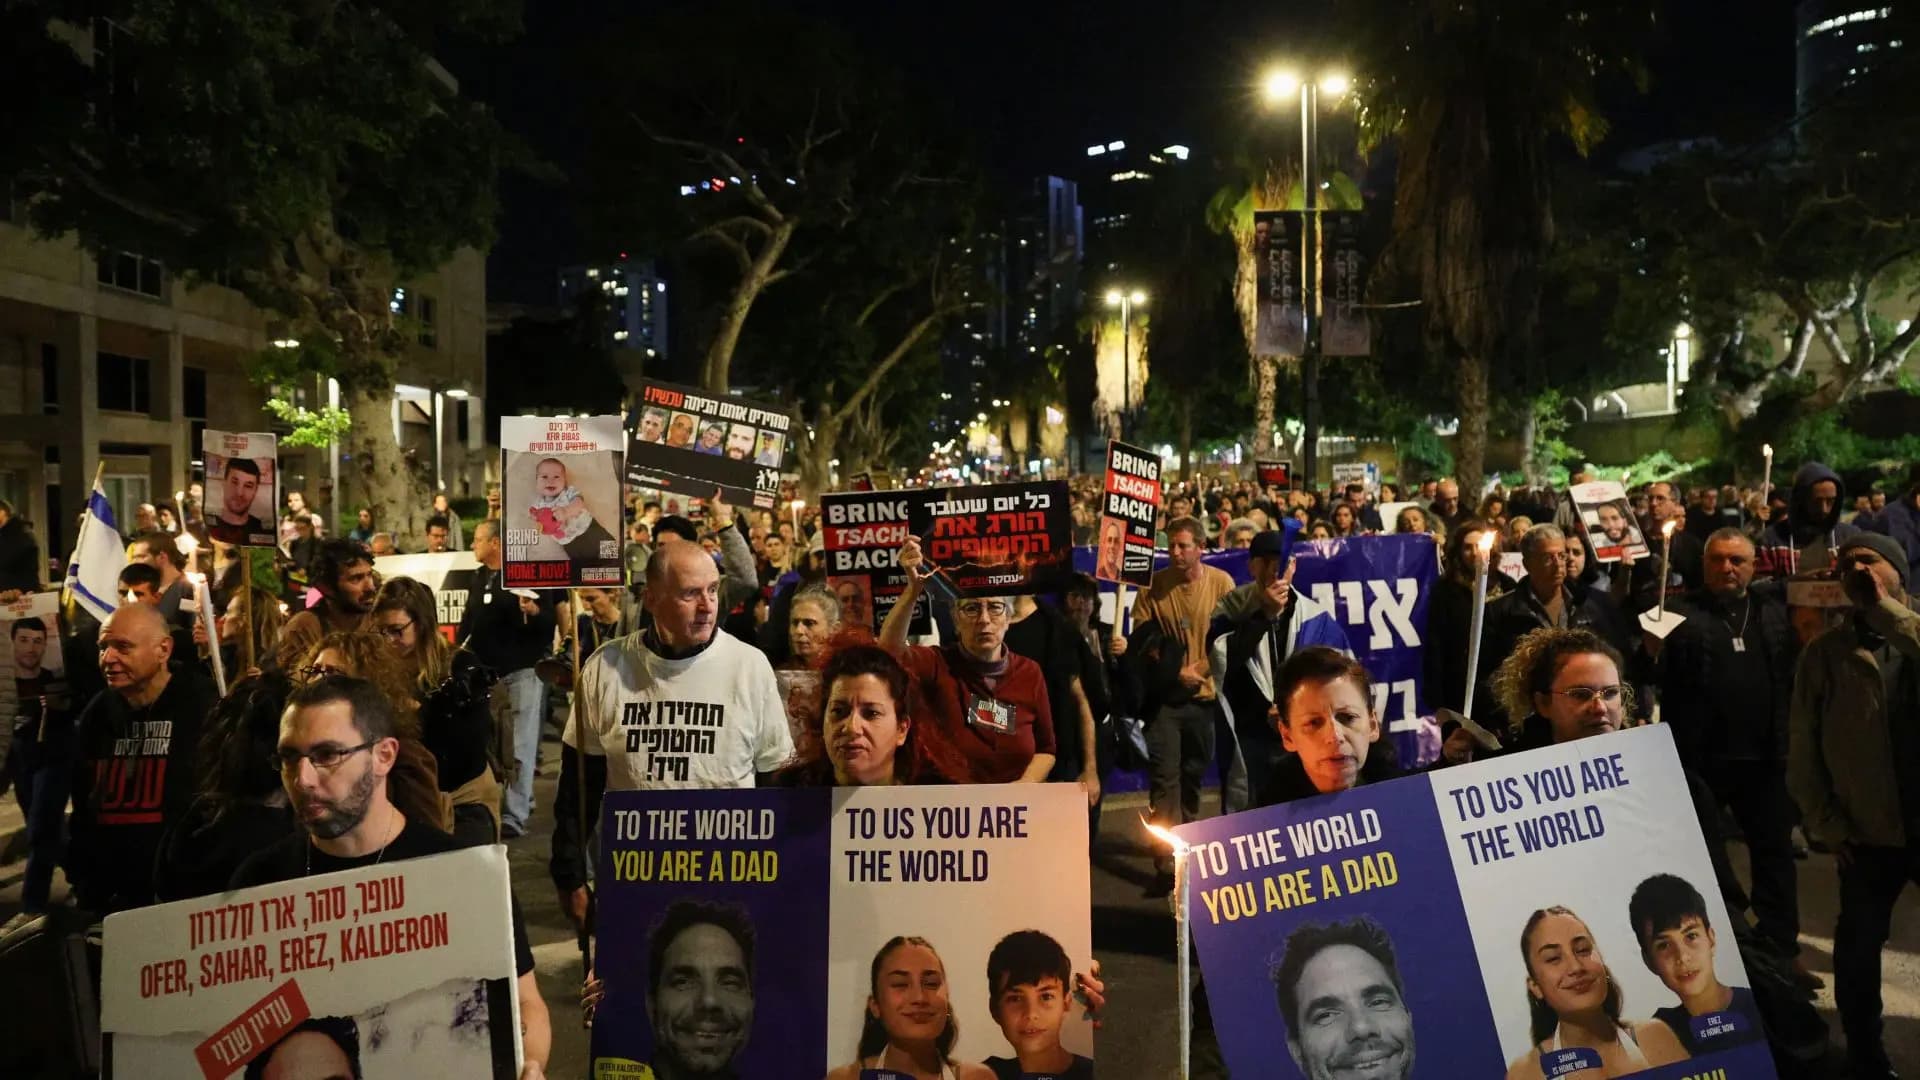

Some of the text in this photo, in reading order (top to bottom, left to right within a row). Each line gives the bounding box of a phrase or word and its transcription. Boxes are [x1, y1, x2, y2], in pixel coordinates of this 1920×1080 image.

[684, 395, 718, 415] הביתה
[719, 402, 748, 422] אותם
[748, 408, 790, 430] מחזירים
[546, 432, 580, 441] KFIR BIBAS
[1111, 450, 1158, 481] BRING
[1112, 473, 1155, 500] TSACHI
[828, 500, 909, 524] BRING
[924, 491, 1051, 516] כל יום שעובר
[1109, 493, 1154, 522] BACK!
[506, 528, 540, 545] BRING
[933, 511, 1046, 538] הורג את
[506, 545, 528, 562] HIM
[931, 533, 1051, 560] החטופים
[506, 563, 537, 579] HOME
[540, 561, 571, 579] NOW!
[621, 701, 724, 728] תחזירו את
[626, 728, 716, 755] החטופים
[646, 752, 690, 782] מיד!
[1449, 753, 1630, 822] TO US YOU ARE
[615, 809, 775, 841] TO THE WORLD
[845, 806, 1028, 840] TO US YOU ARE
[1461, 805, 1605, 866] THE WORLD
[1191, 808, 1382, 880] TO THE WORLD
[612, 850, 778, 882] YOU ARE A DAD
[844, 850, 989, 882] THE WORLD
[1200, 851, 1399, 925] YOU ARE A DAD
[188, 875, 405, 951] עופר, סהר, ארז קלדרון
[140, 911, 449, 1000] OFER, SAHAR, EREZ, KALDERON
[211, 995, 293, 1067] עדיין שבוי
[1706, 1026, 1722, 1037] HOME
[1721, 1023, 1736, 1034] NOW
[1707, 1015, 1721, 1026] EREZ
[1558, 1052, 1577, 1063] SAHAR
[1558, 1063, 1575, 1075] HOME
[1574, 1060, 1588, 1070] NOW
